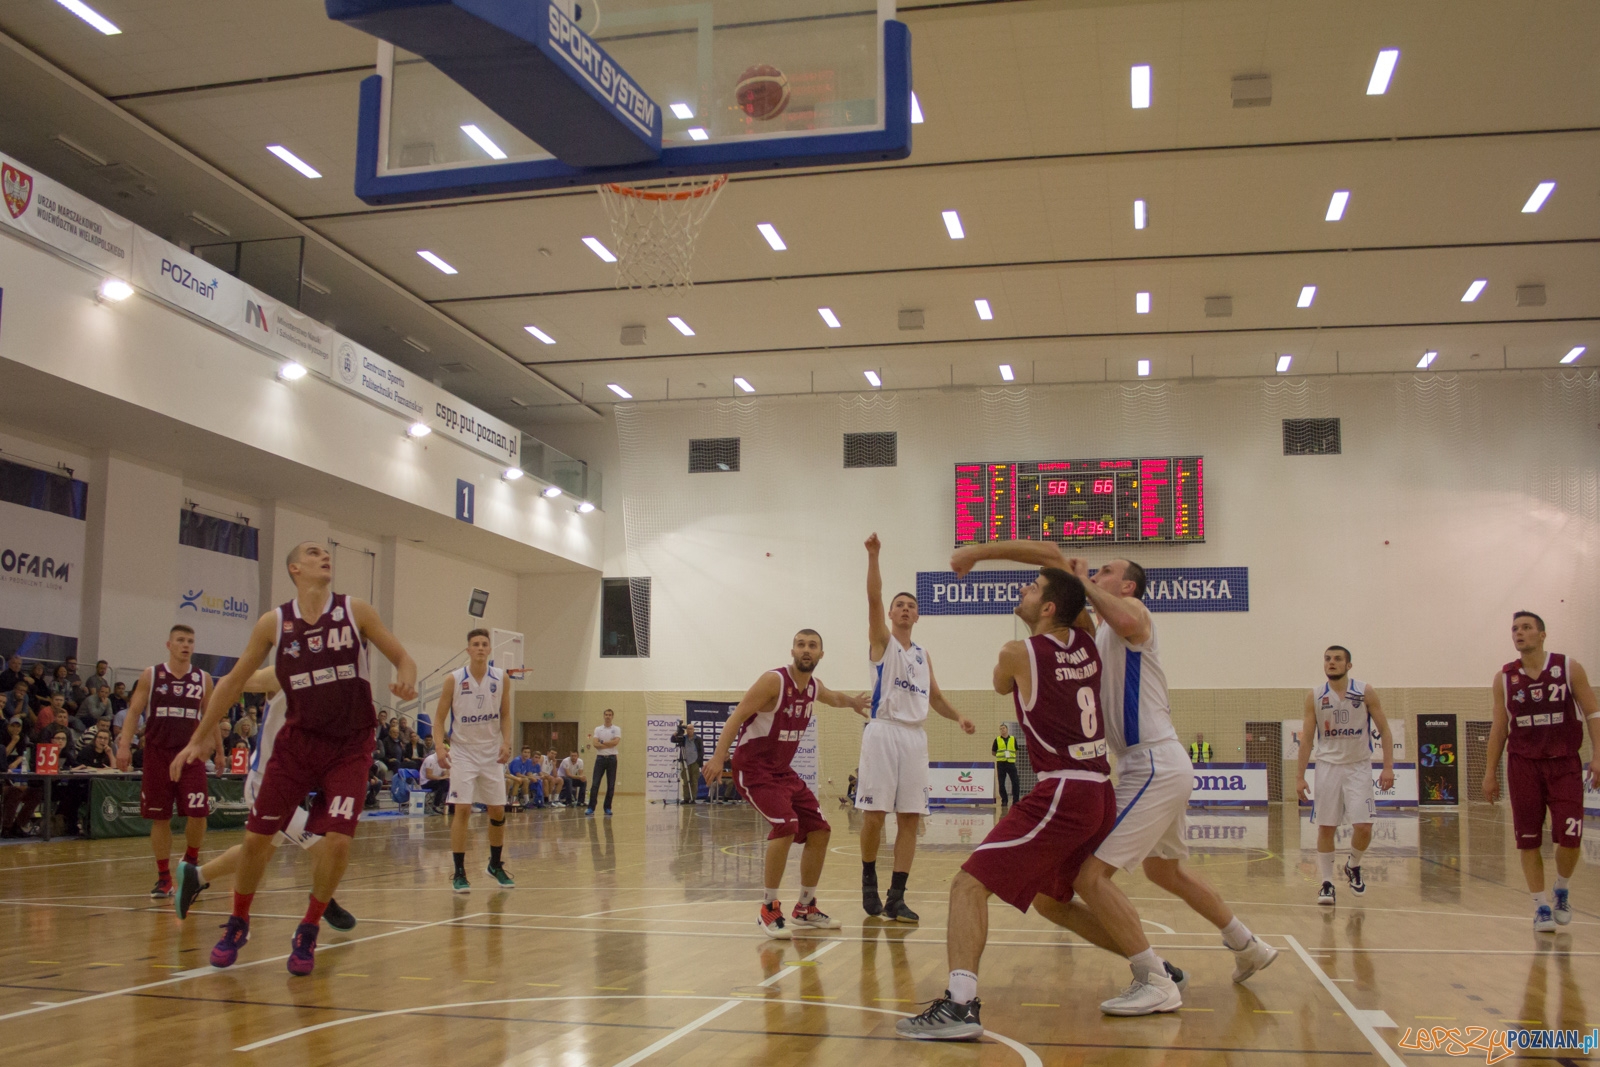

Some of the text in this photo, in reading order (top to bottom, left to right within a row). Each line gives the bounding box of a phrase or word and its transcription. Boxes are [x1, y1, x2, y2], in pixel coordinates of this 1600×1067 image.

[549, 5, 654, 128] SPORT SYSTEM
[363, 357, 387, 379] Centrum
[362, 374, 393, 400] Politechniki
[436, 402, 517, 458] cspp.put.poznan.pl
[1048, 480, 1113, 495] 58 66
[463, 486, 470, 519] 1
[933, 583, 1026, 602] POLITEC
[327, 625, 354, 651] 44
[186, 683, 203, 700] 22
[291, 678, 307, 687] PEC
[476, 695, 485, 709] 7
[1548, 683, 1567, 702] 21
[461, 713, 499, 723] BIOFARM
[1076, 686, 1098, 739] 8
[1333, 709, 1350, 724] 10
[233, 750, 245, 767] 5
[187, 792, 205, 809] 22
[328, 795, 355, 820] 44
[1565, 817, 1582, 837] 21
